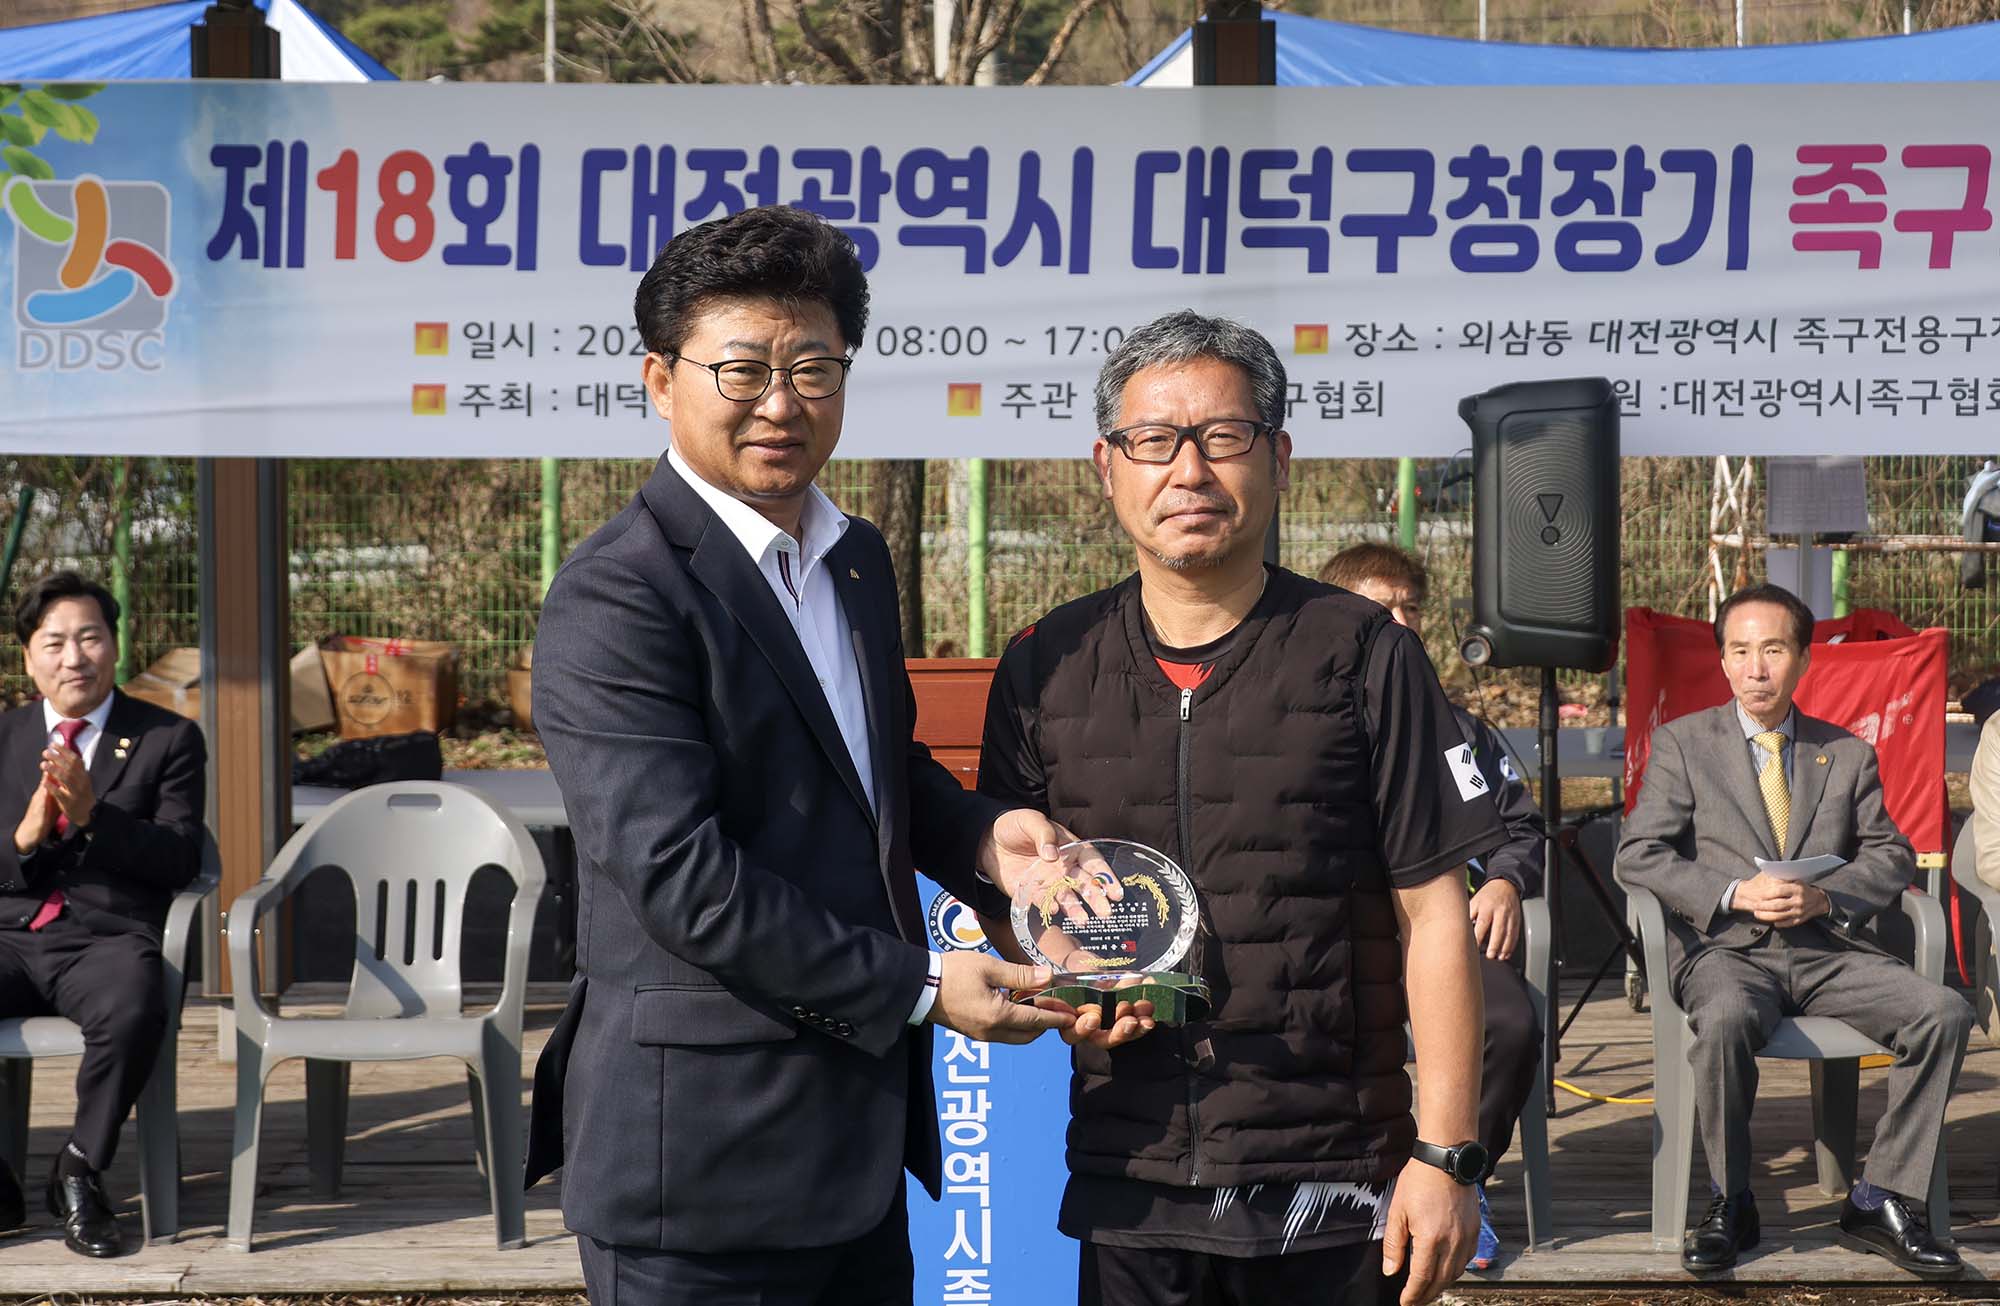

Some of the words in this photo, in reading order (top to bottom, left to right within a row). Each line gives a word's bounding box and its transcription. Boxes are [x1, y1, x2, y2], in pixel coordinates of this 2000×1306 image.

[205, 139, 542, 272] 제18회
[1131, 143, 1753, 274] 대덕구청장기
[1788, 144, 1993, 270] 족구
[18, 329, 163, 372] DDSC
[462, 320, 535, 360] 일시
[876, 325, 988, 357] 08:00
[1345, 322, 1419, 358] 장소
[1458, 320, 1573, 357] 외삼동
[1588, 317, 1778, 356] 대전광역시
[459, 382, 533, 419] 주최
[577, 382, 647, 419] 대덕
[1001, 381, 1078, 420] 주관
